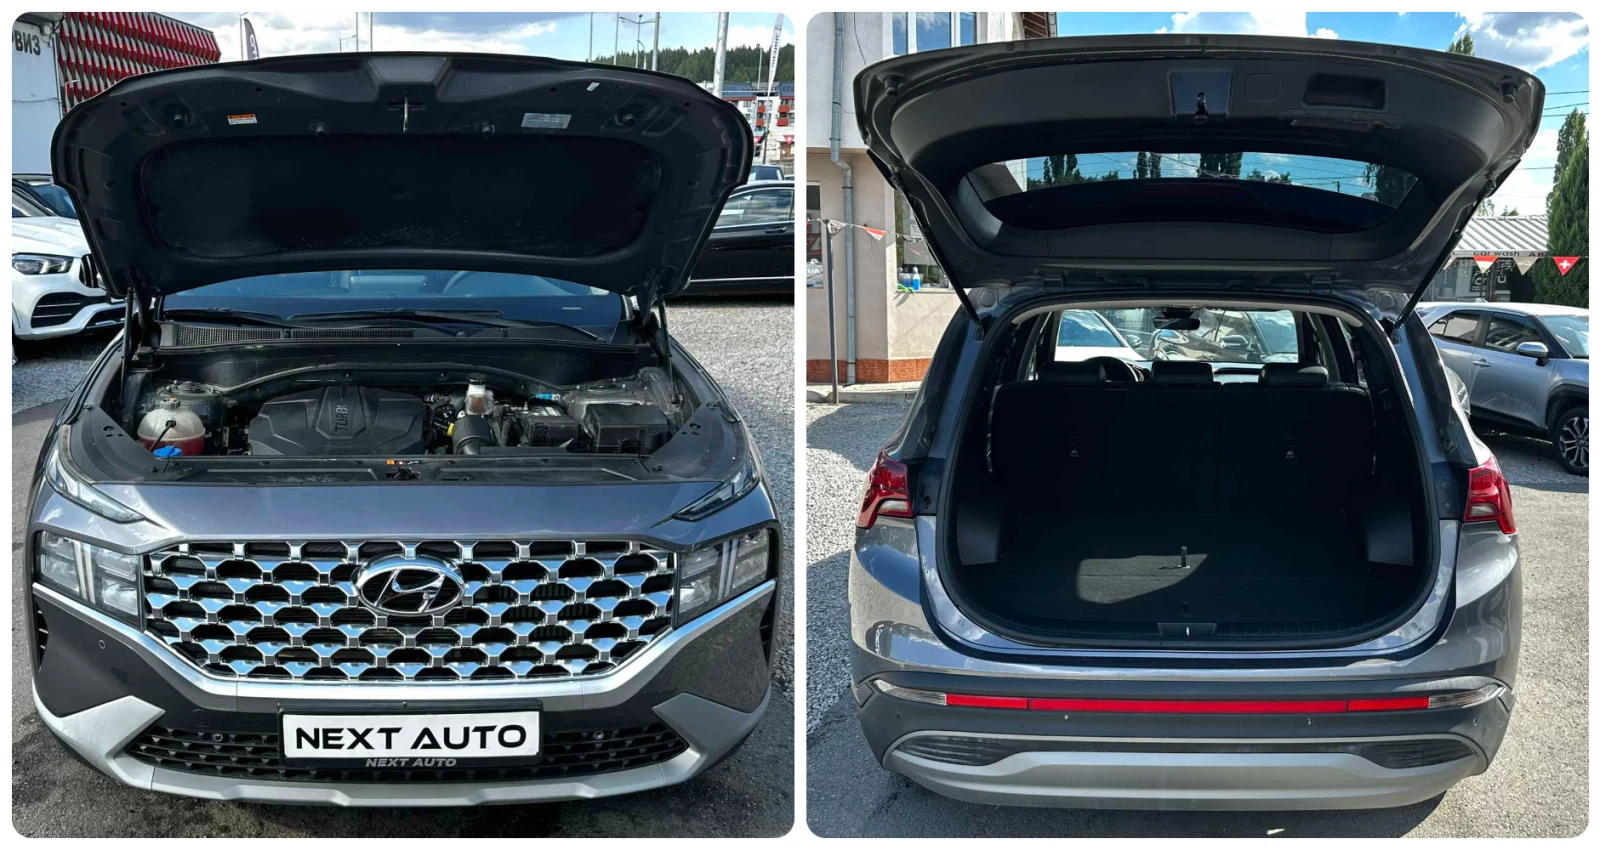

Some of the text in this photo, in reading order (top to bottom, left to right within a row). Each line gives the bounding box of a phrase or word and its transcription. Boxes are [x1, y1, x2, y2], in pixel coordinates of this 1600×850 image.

[12, 30, 41, 56] ВИЗ
[335, 401, 348, 432] TURBO
[296, 724, 527, 750] NEXT AUTO
[365, 758, 457, 768] NEXT AUTO
